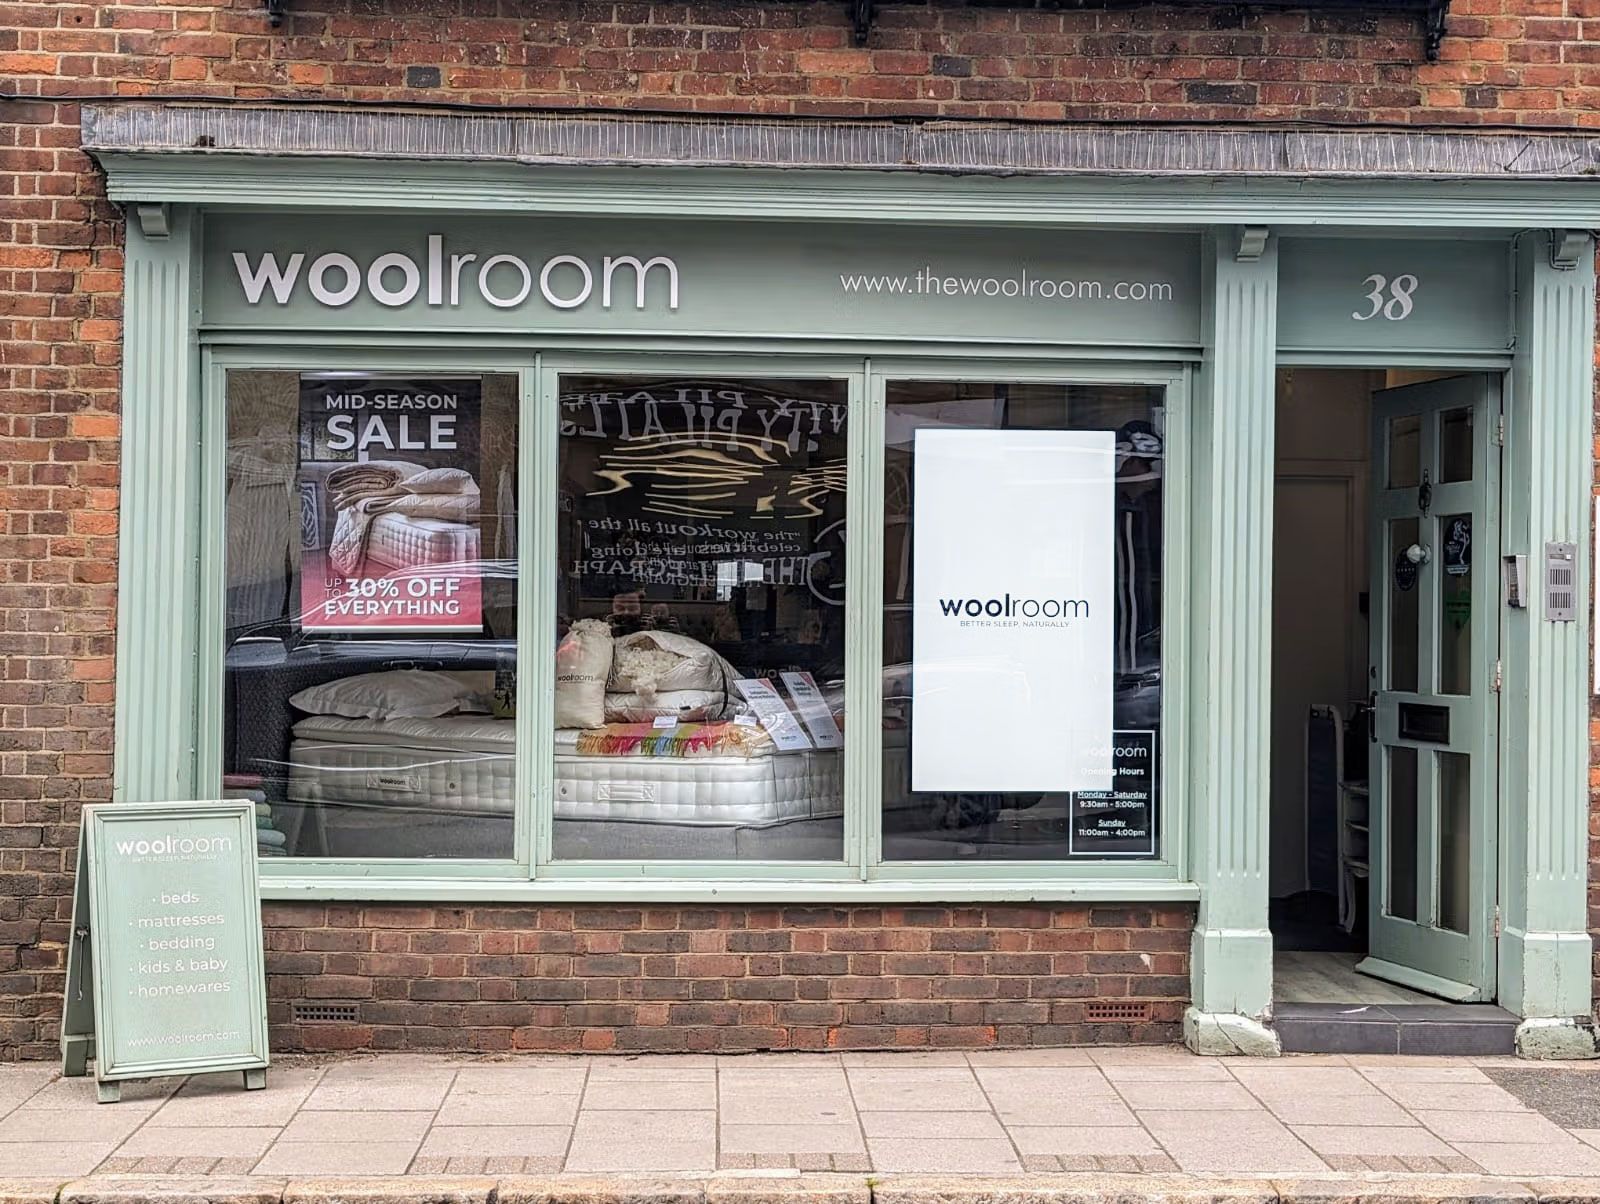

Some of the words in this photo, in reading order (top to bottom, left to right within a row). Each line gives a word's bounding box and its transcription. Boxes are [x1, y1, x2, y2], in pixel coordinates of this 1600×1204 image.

[231, 234, 680, 310] woolroom
[839, 265, 1174, 301] www.thewoolroom.com
[1352, 273, 1419, 321] 38
[326, 394, 458, 410] MID-SEASON
[326, 414, 458, 451] SALE
[324, 577, 342, 588] UP
[345, 577, 400, 599] 30%
[407, 577, 461, 598] OFF
[324, 599, 461, 616] EVERYTHING
[939, 593, 1089, 618] woolroom
[960, 620, 991, 628] BETTER
[1023, 620, 1069, 628] NATURALLY
[1119, 767, 1145, 776] Hours
[1077, 791, 1108, 799] Monday
[1114, 791, 1148, 800] Saturday
[1080, 800, 1109, 808] 9:30am
[1115, 800, 1145, 809] 5:00pm
[1098, 819, 1127, 828] Sunday
[1078, 828, 1109, 837] 11:00am
[1115, 828, 1146, 838] 4:00pm
[116, 835, 232, 856] woolroom
[160, 891, 200, 905] beds
[138, 913, 225, 929] mattresses
[149, 936, 215, 951] bedding
[138, 960, 171, 974] kids
[175, 959, 186, 973] &
[190, 957, 229, 974] baby
[138, 980, 231, 997] homewares
